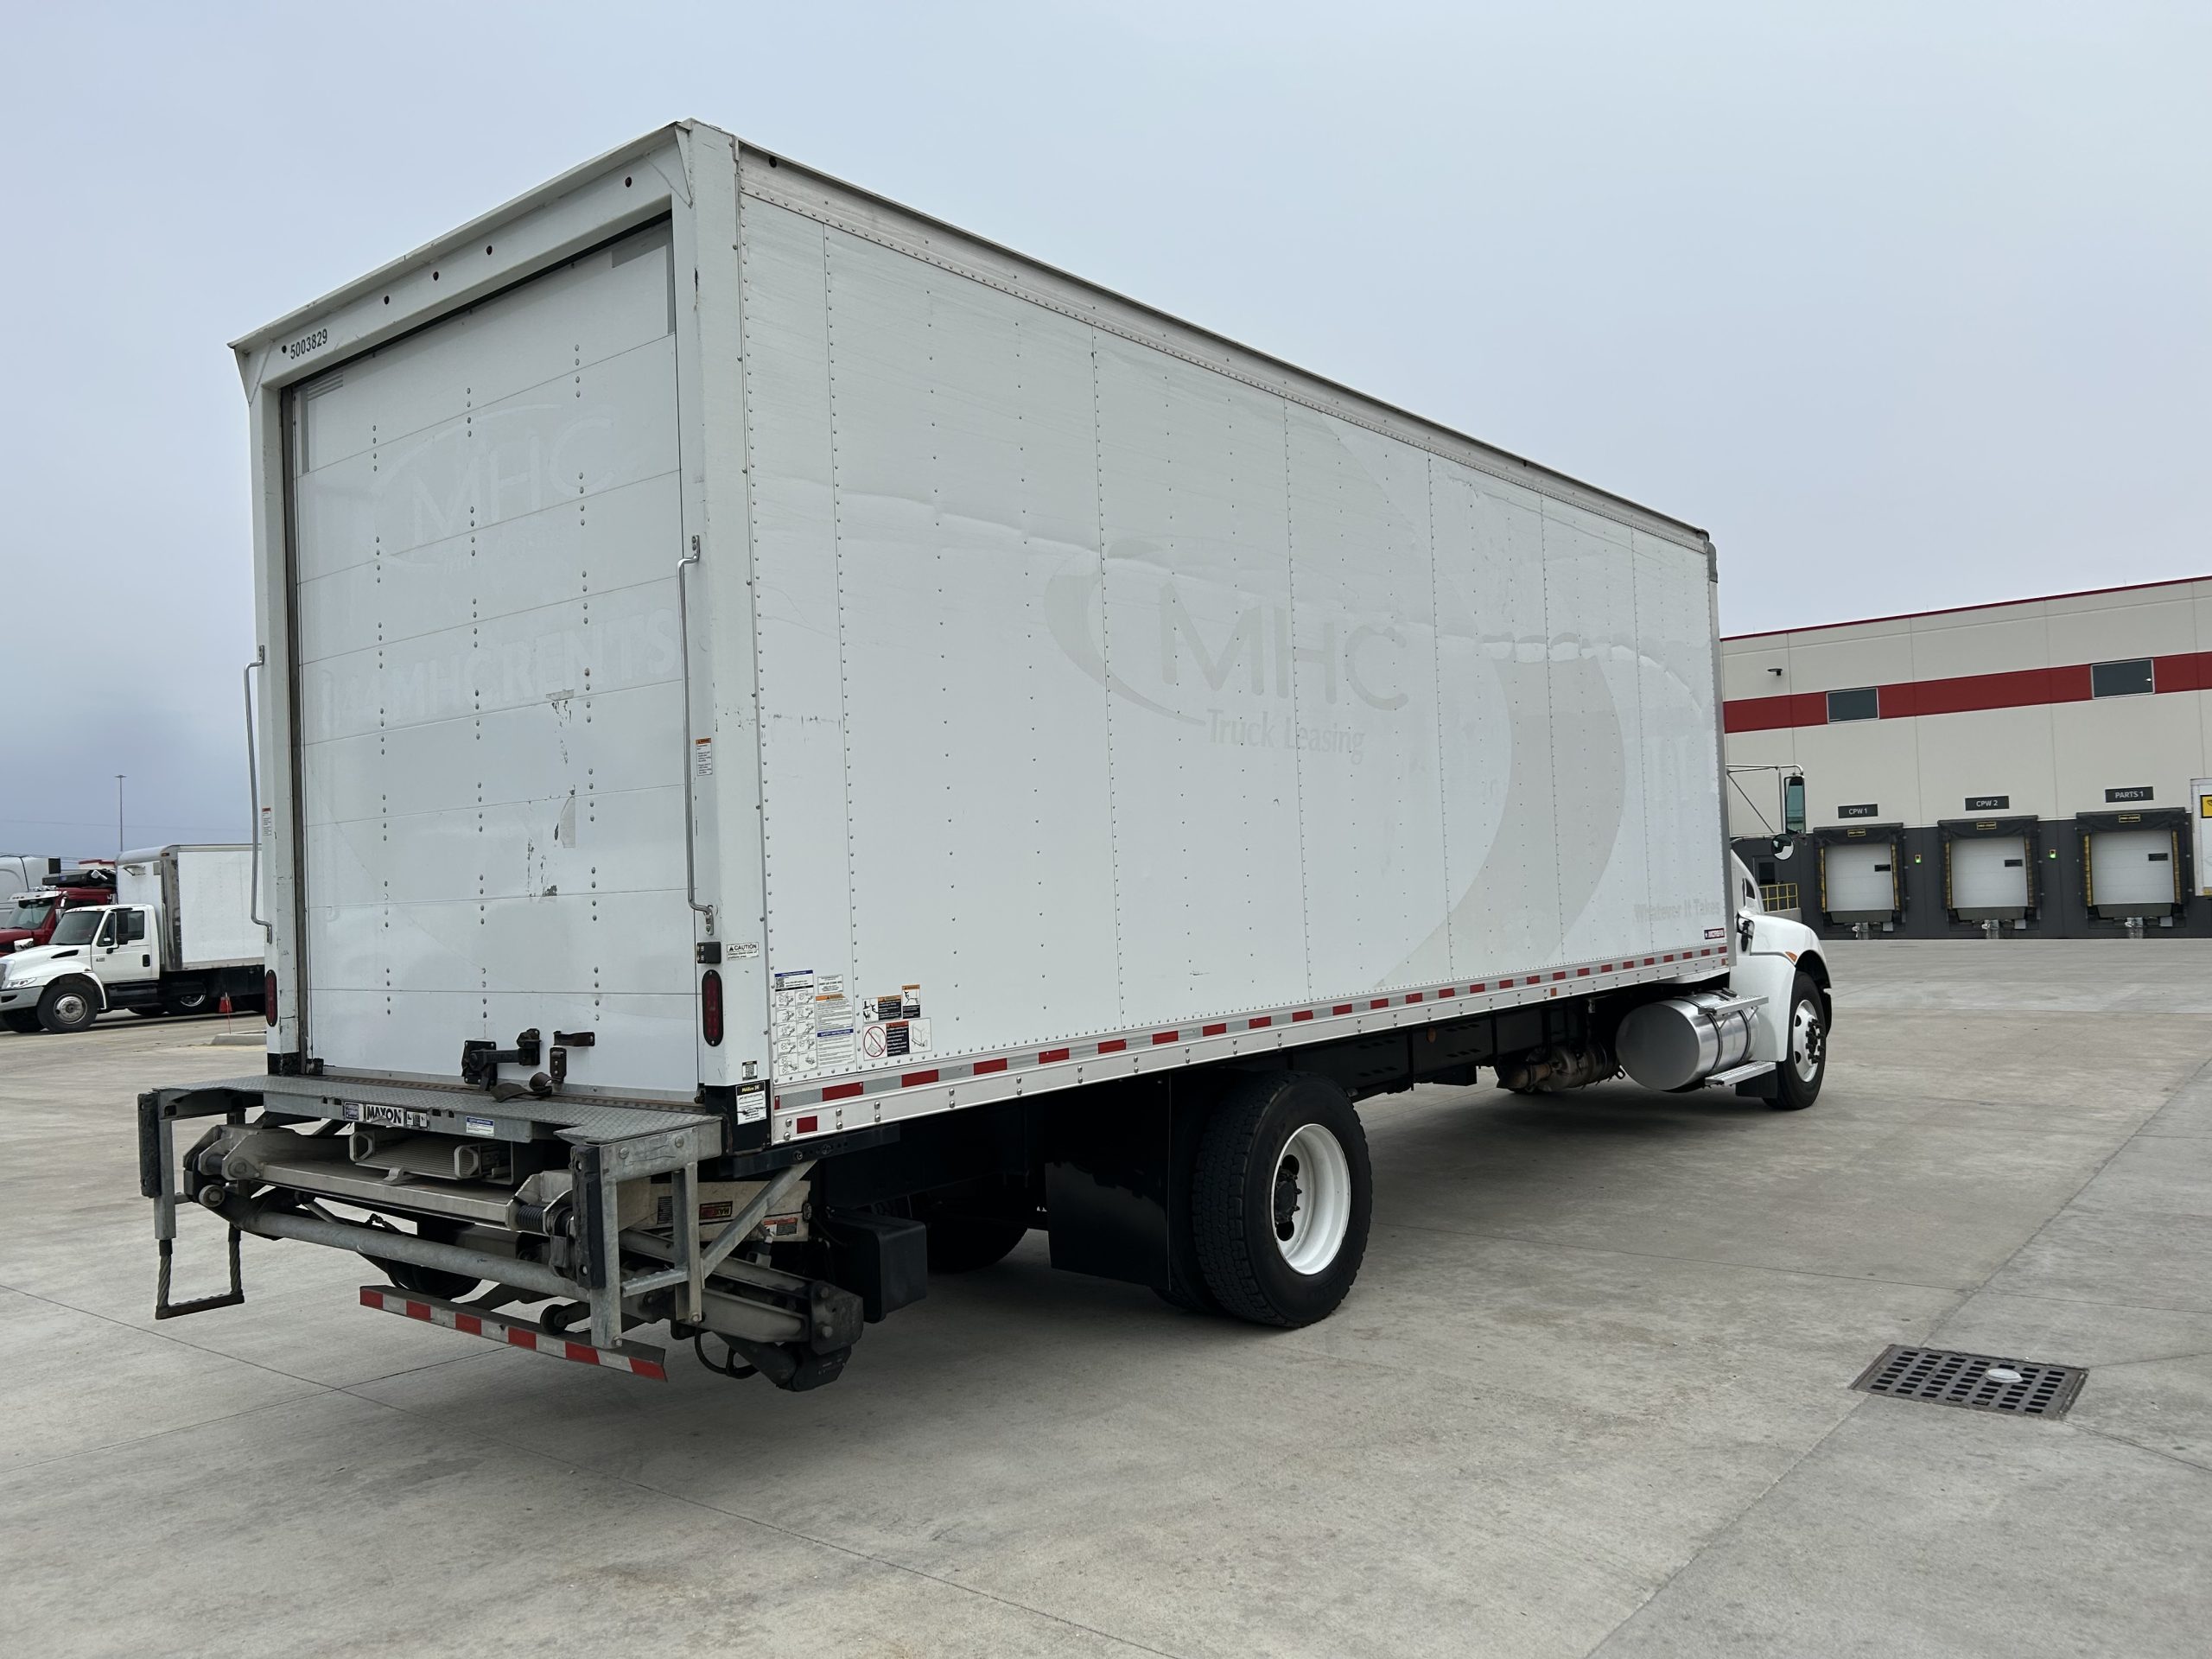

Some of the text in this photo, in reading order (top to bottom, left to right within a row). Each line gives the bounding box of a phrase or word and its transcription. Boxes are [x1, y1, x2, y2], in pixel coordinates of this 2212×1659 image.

[290, 328, 328, 359] 5003829
[1159, 582, 1408, 711] MHC
[1207, 708, 1365, 766] Truck Leasing
[366, 1105, 402, 1124] MAXON
